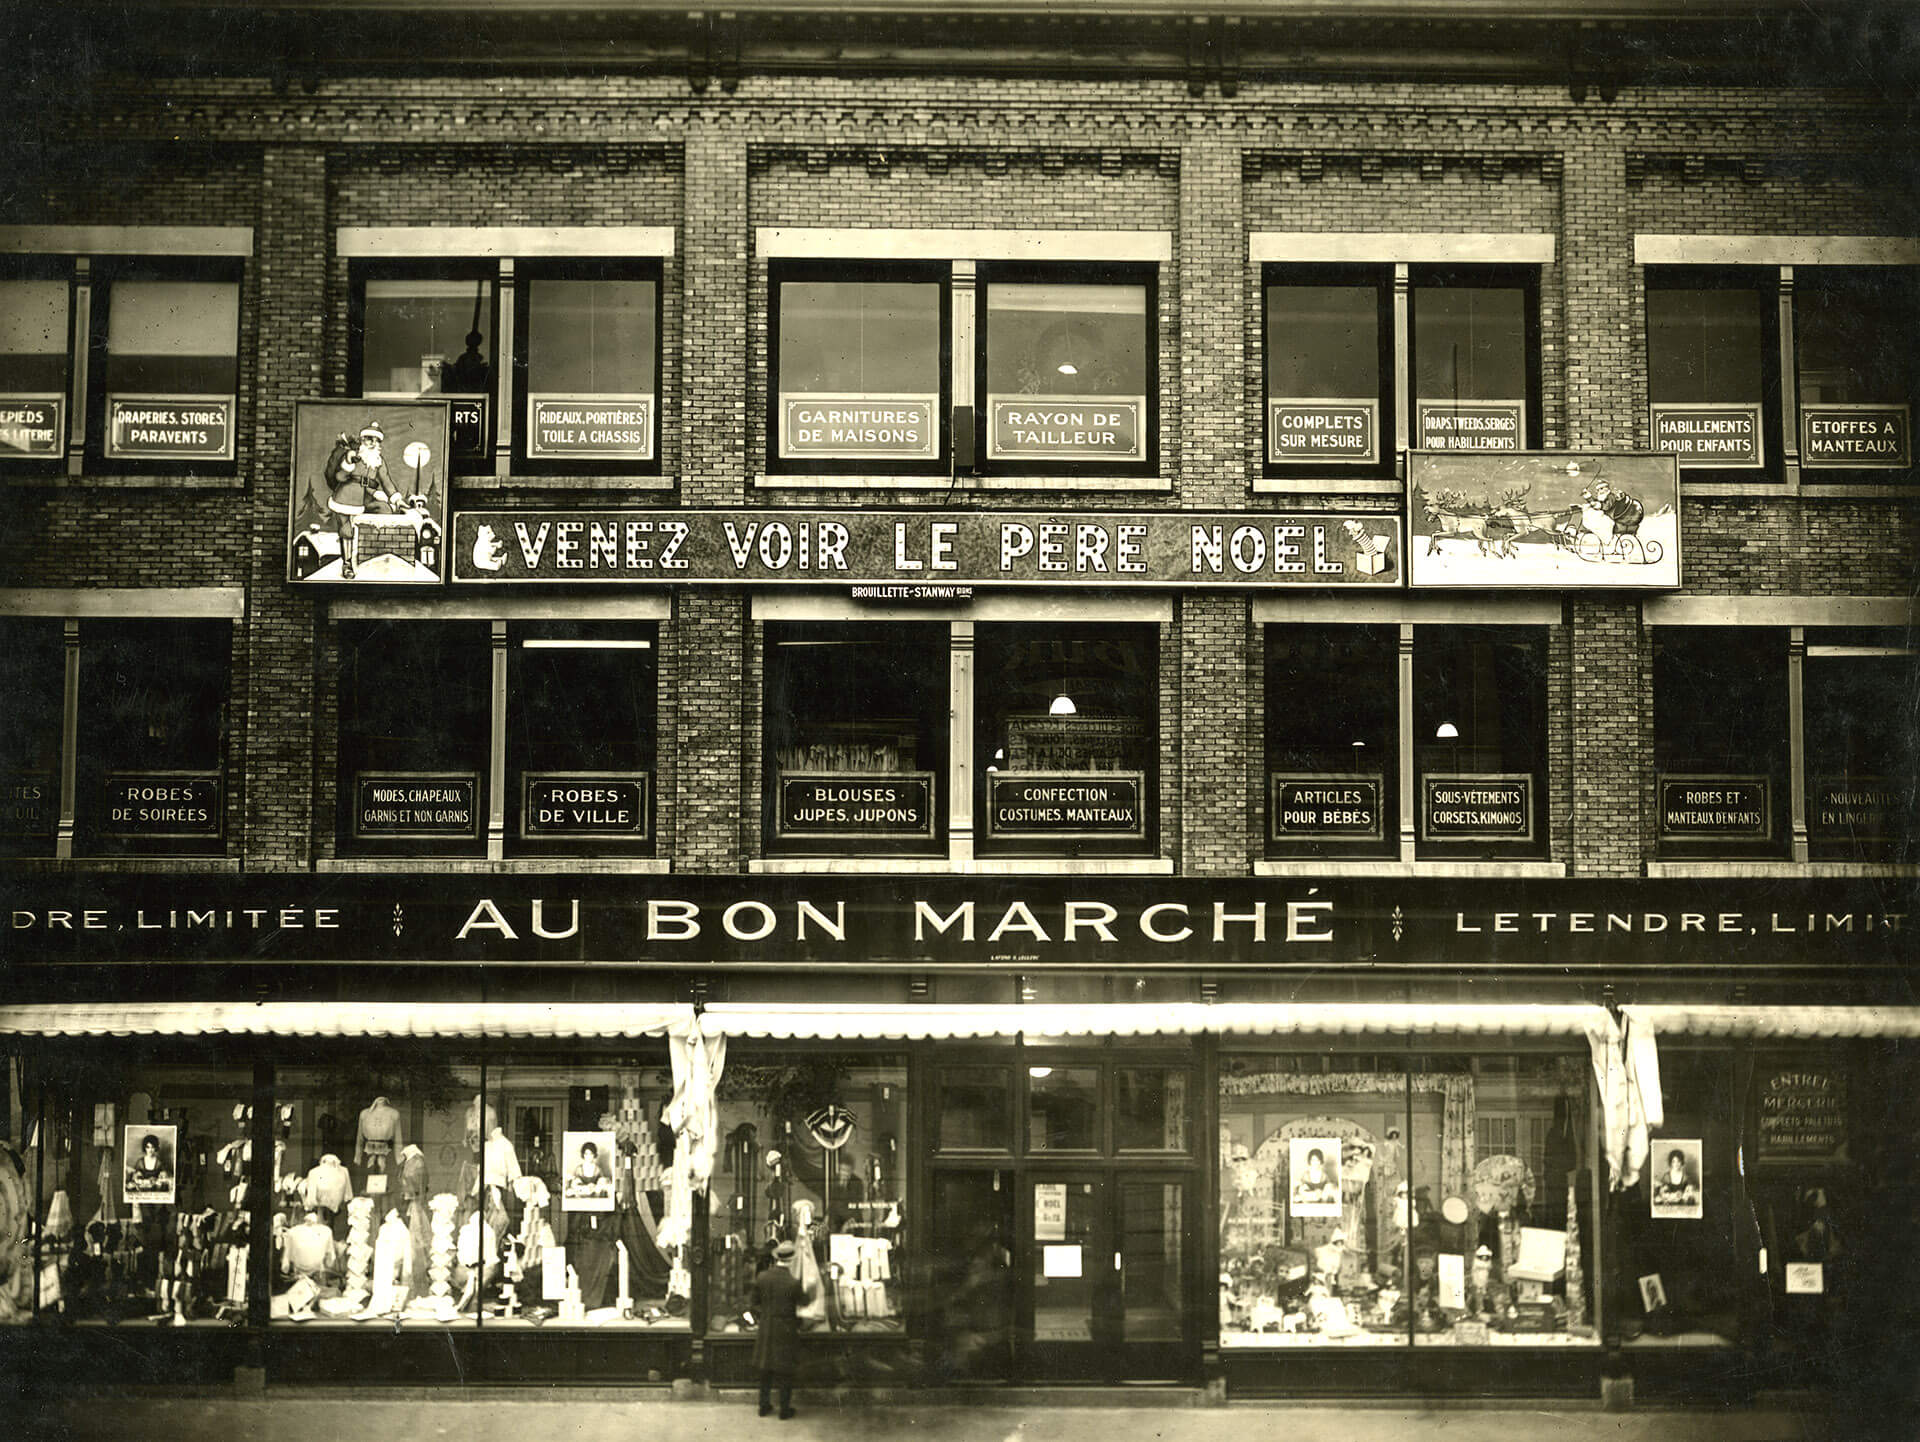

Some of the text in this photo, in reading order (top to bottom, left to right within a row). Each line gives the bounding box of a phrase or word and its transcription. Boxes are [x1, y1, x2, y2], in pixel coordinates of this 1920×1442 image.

[798, 410, 920, 424] GARNITURES
[1007, 412, 1121, 426] RAYON DE
[1282, 415, 1363, 429] COMPLETS
[1660, 420, 1751, 433] HABILLEMENTS
[1811, 421, 1895, 434] ETOFFES A
[131, 429, 207, 443] PARAVENTS
[542, 430, 641, 443] TOILE A CHASSIS
[798, 429, 918, 443] DE MAISONS
[1013, 430, 1116, 445] TAILLEUR
[1280, 434, 1363, 448] SUR MESURE
[1426, 436, 1515, 449] POUR HABILLEMENTS
[1660, 439, 1751, 452] POUR ENFANTS
[1811, 440, 1898, 453] MANTEAUX
[514, 518, 1345, 575] VENEZ VOIR LE PÈRE NOËL
[127, 787, 193, 801] ROBES
[408, 789, 461, 803] CHAPEAUX
[551, 789, 619, 803] ROBES
[815, 788, 896, 802] BLOUSES
[1023, 788, 1108, 801] CONFECTION
[1294, 790, 1362, 804] ARTICLES
[1686, 791, 1741, 804] ROBES ET
[112, 805, 207, 821] DE SOIRÉES
[364, 809, 469, 823] GARNIS ET NON GARNIS
[539, 810, 629, 824] DE VILLE
[853, 808, 917, 822] JUPONS
[1066, 808, 1134, 821] MANTEAUX
[1284, 808, 1371, 824] POUR BÉBÉS
[1480, 811, 1522, 825] KIMONOS
[1667, 811, 1714, 824] MANTEAUX
[137, 904, 341, 929] LIMITÉE
[455, 887, 1335, 942] AU BON MARCHÉ
